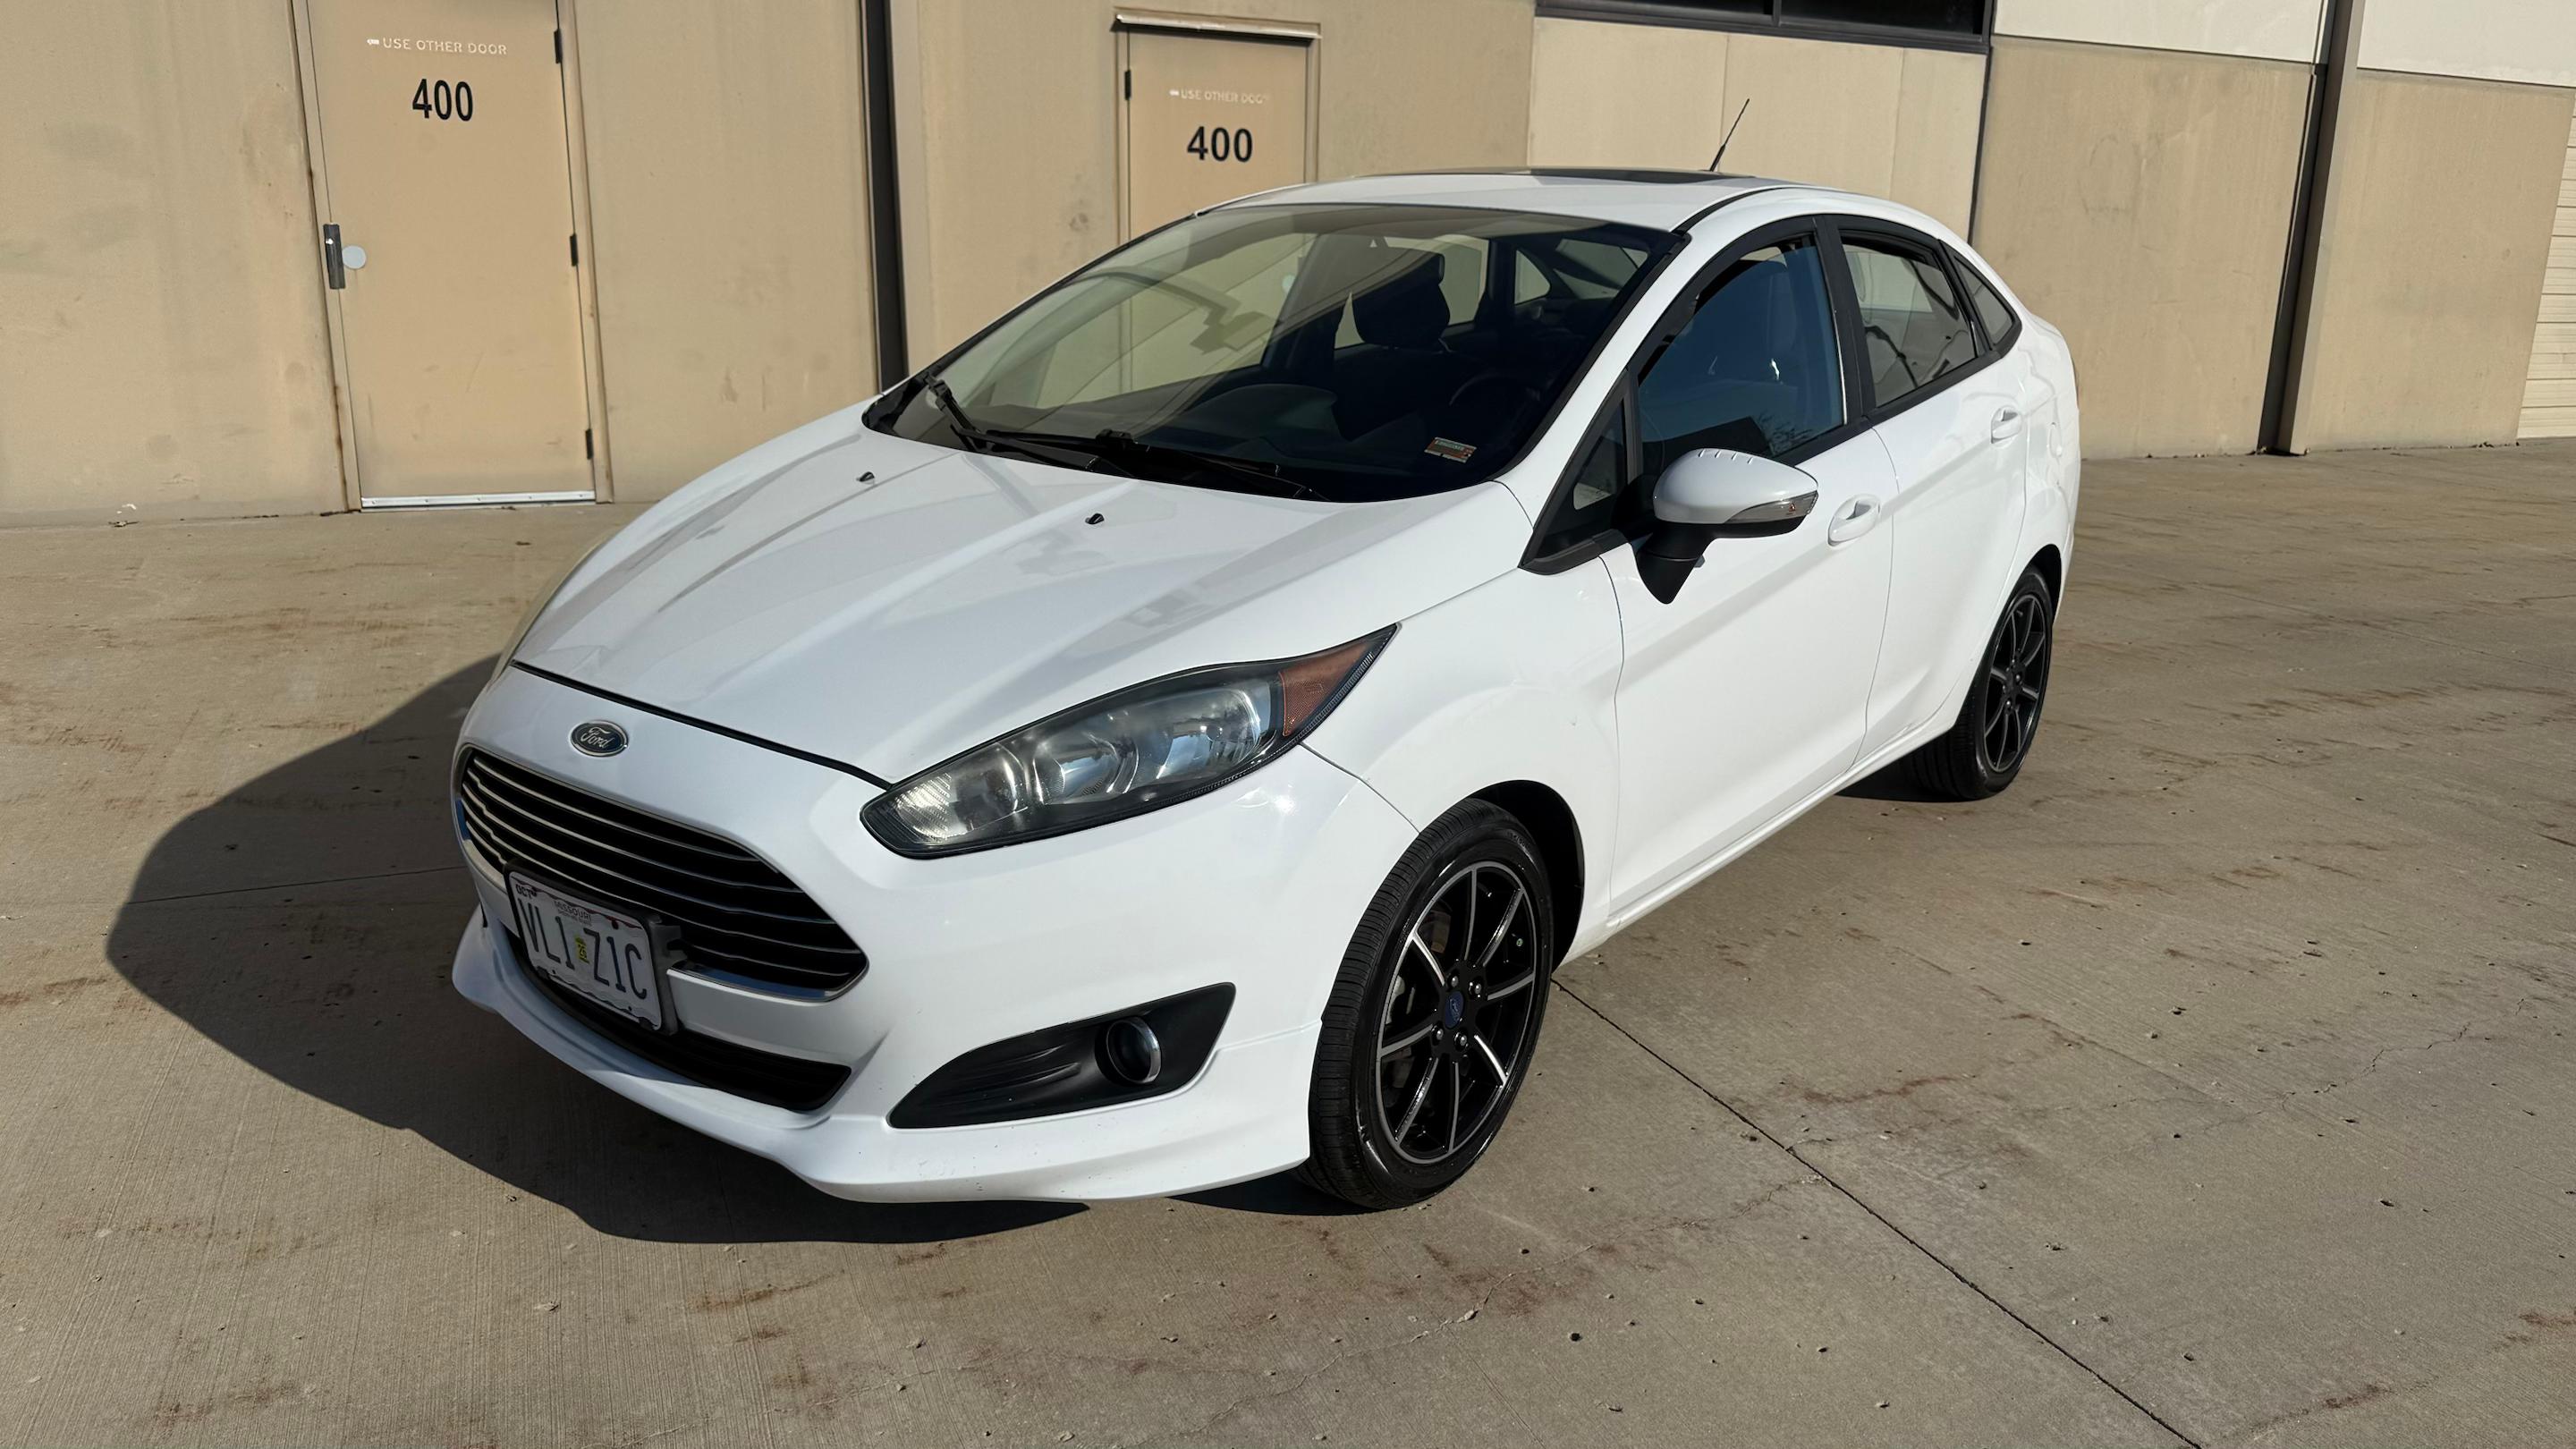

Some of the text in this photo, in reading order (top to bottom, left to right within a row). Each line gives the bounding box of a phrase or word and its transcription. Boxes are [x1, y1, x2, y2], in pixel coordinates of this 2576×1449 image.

[383, 38, 507, 55] USE OTHER DOOR
[412, 79, 473, 122] 400
[1181, 89, 1201, 100] USE
[1204, 90, 1239, 103] OTHER
[1187, 126, 1253, 163] 400
[580, 726, 616, 749] Ford
[518, 898, 648, 1000] VL1 Z1C
